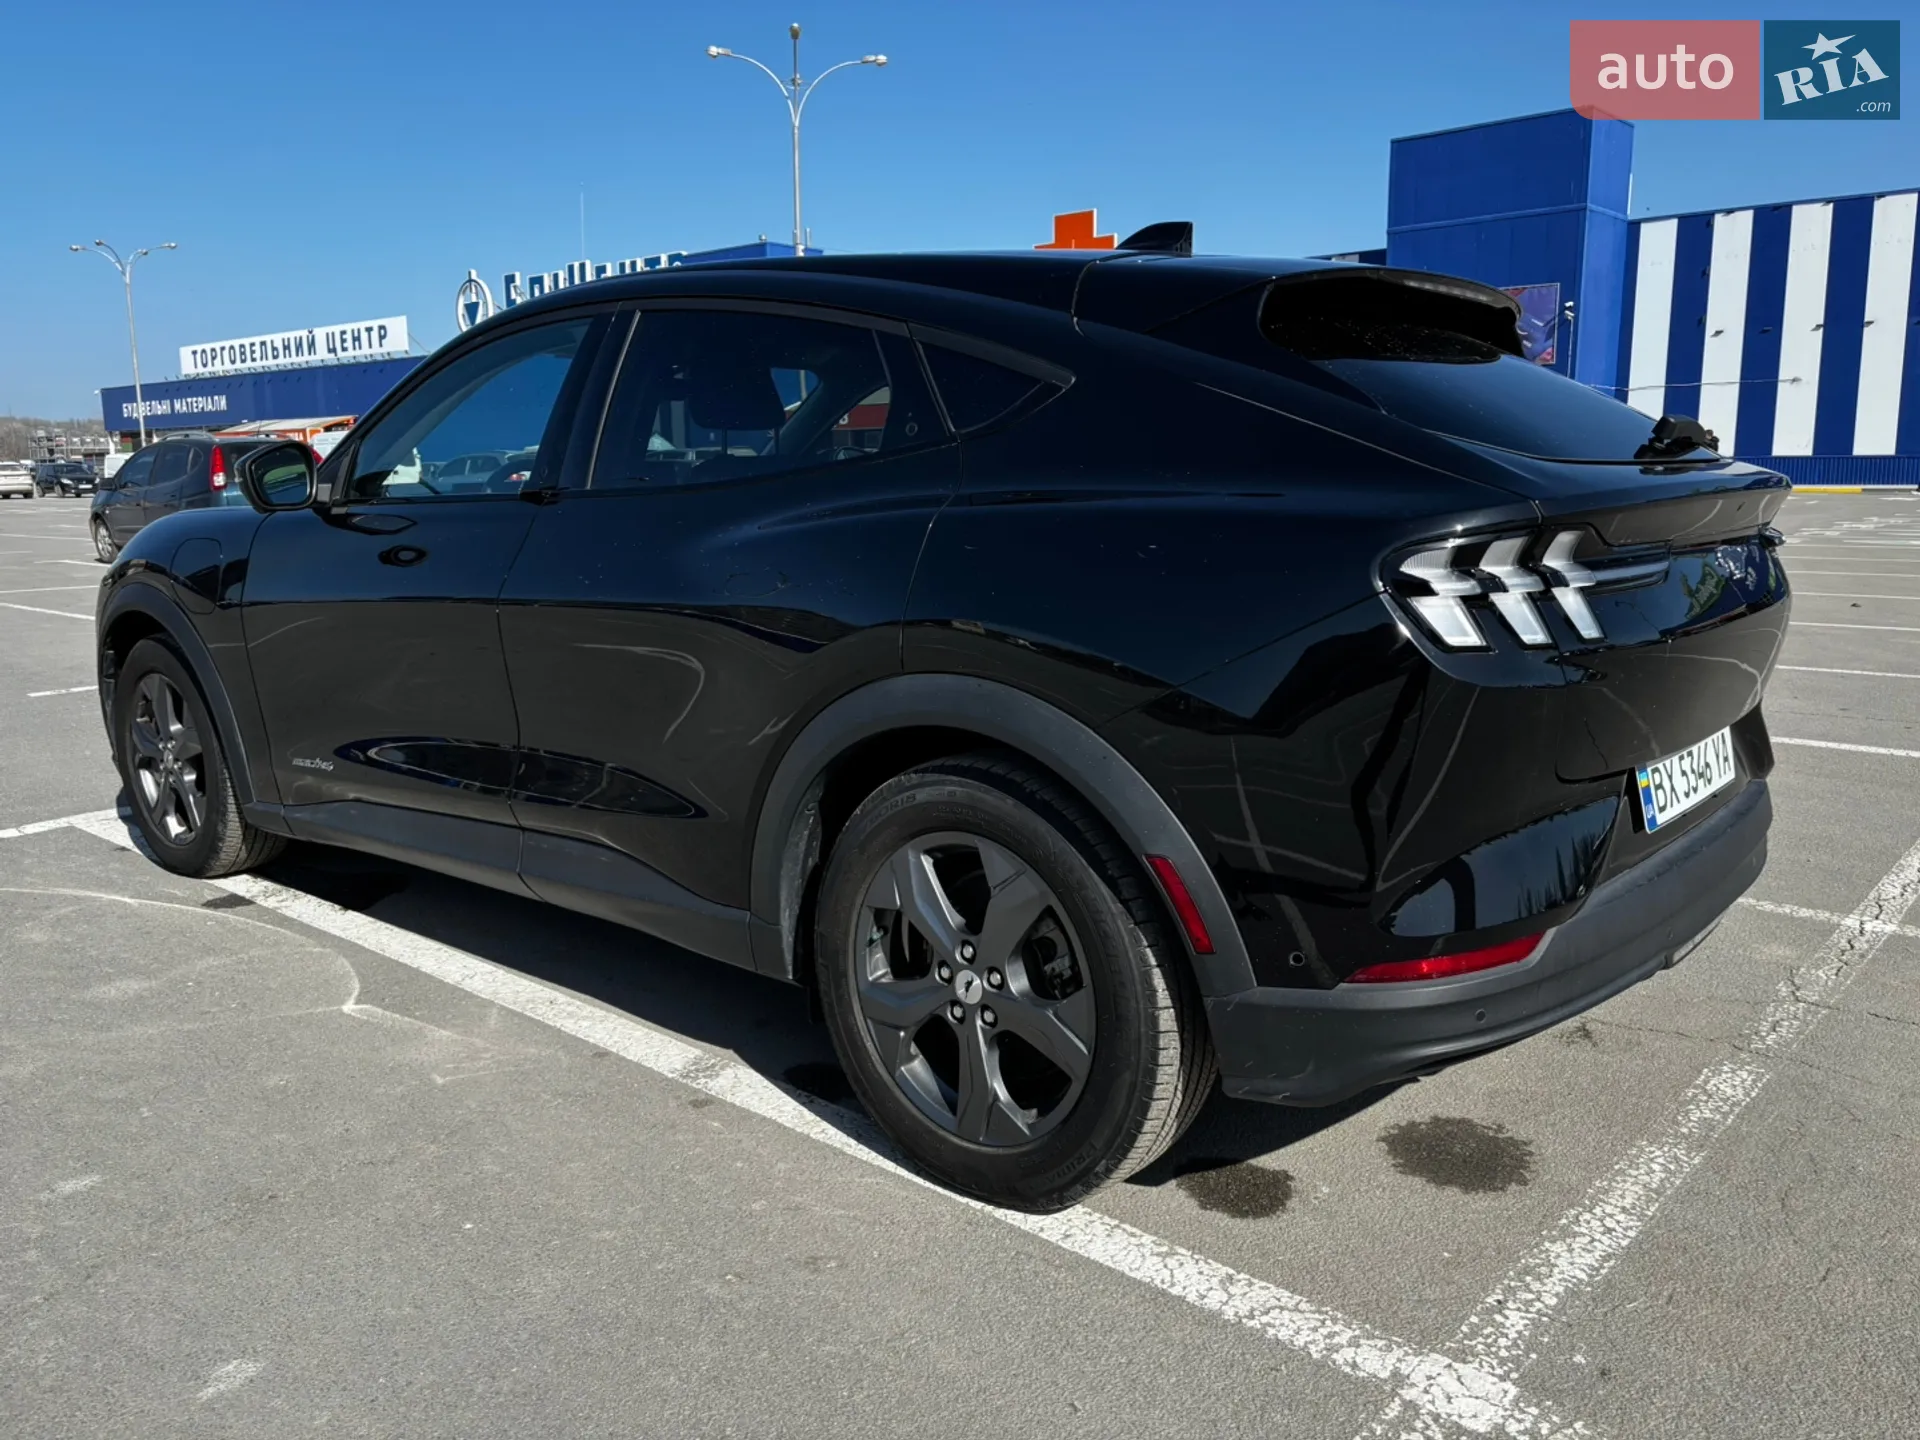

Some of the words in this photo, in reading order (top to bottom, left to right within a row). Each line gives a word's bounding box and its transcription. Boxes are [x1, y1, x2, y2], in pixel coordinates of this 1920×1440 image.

[191, 328, 317, 369] ТОРГОВЕЛЬНИЙ
[325, 324, 389, 357] ЦЕНТР
[122, 398, 171, 419] БУДВЕЛЬНІ
[173, 394, 228, 414] МАТЕРІАЛИ
[1651, 759, 1680, 814] BX
[1678, 741, 1713, 799] 5346
[1712, 732, 1732, 779] YA
